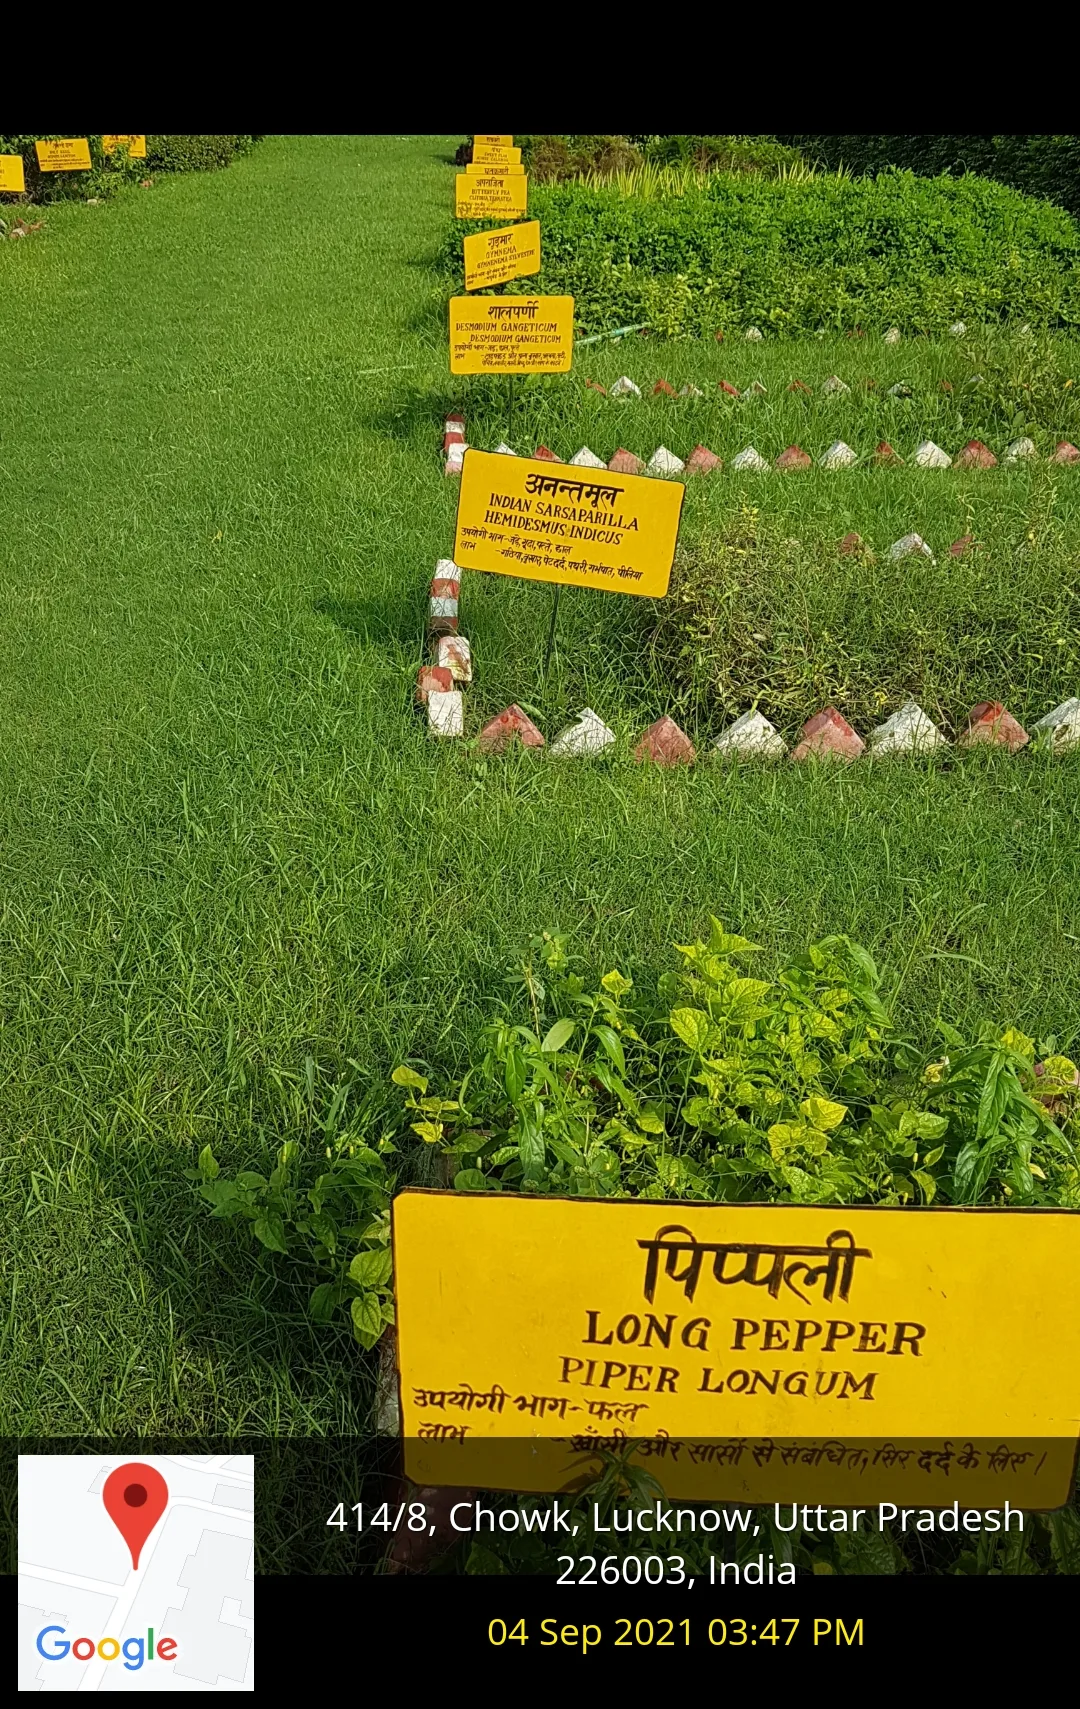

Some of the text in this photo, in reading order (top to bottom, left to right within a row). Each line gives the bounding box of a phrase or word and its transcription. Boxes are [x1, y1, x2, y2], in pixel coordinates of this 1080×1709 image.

[485, 245, 517, 259] GYMNEMA
[488, 300, 539, 322] शालपर्णी
[456, 322, 558, 332] DESMODIUM GANGETICUM
[470, 334, 561, 343] DESMODIUM GANGETICUM
[525, 473, 625, 511] अनन्तमूल
[489, 492, 639, 532] INDIAN SARSAPARILLA
[484, 510, 624, 545] HEMIDESMUS INDICUS
[460, 540, 477, 552] लाभ
[617, 565, 644, 582] पीलिया
[637, 1225, 873, 1305] पिप्पली
[583, 1310, 926, 1357] LONG PEPPER
[558, 1356, 879, 1400] PIPER LONGUM
[412, 1383, 511, 1413] उपयोगी
[418, 1421, 473, 1445] लाभ
[637, 1429, 686, 1462] और
[752, 1437, 779, 1468] से
[872, 1442, 916, 1469] सिर
[917, 1440, 956, 1475] दर्द
[956, 1442, 982, 1468] के
